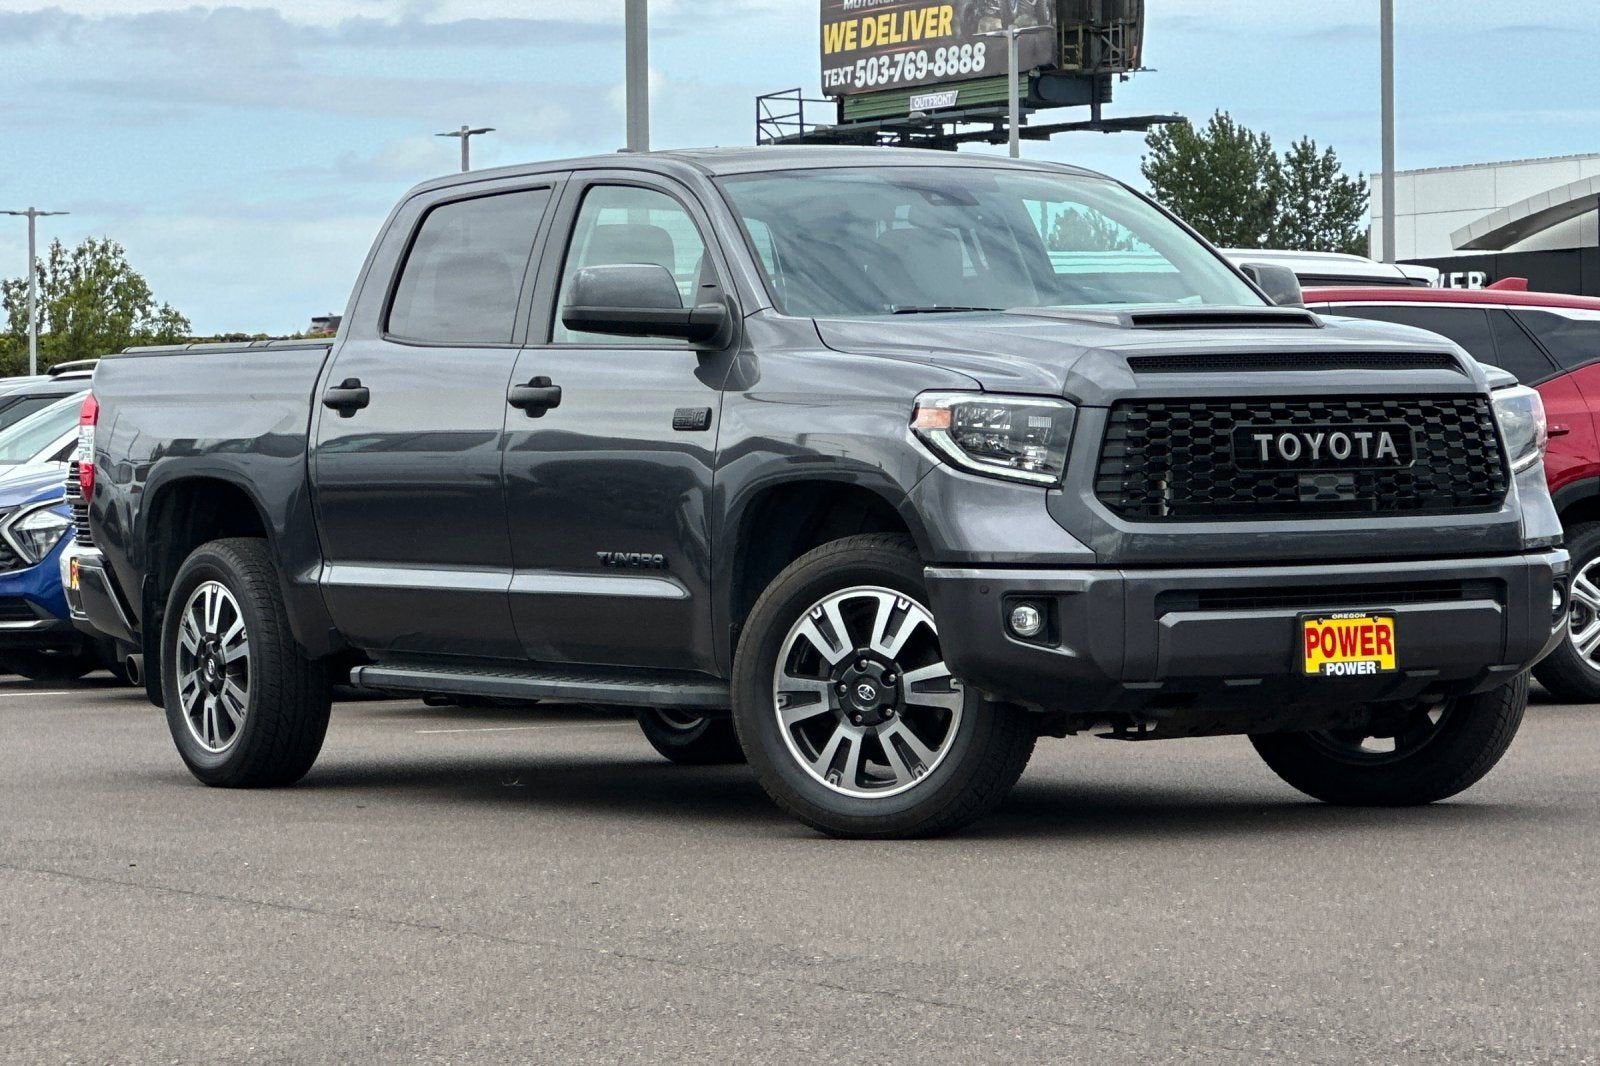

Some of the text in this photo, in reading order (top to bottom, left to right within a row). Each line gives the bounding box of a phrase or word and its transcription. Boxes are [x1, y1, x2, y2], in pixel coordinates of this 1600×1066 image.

[824, 5, 953, 55] WE DELIVER
[823, 42, 986, 88] TEXT 503-769-8888
[913, 94, 953, 107] OUTFRONT
[1254, 432, 1399, 461] TOYOTA
[1305, 624, 1392, 659] POWER
[1326, 661, 1376, 676] POWER
